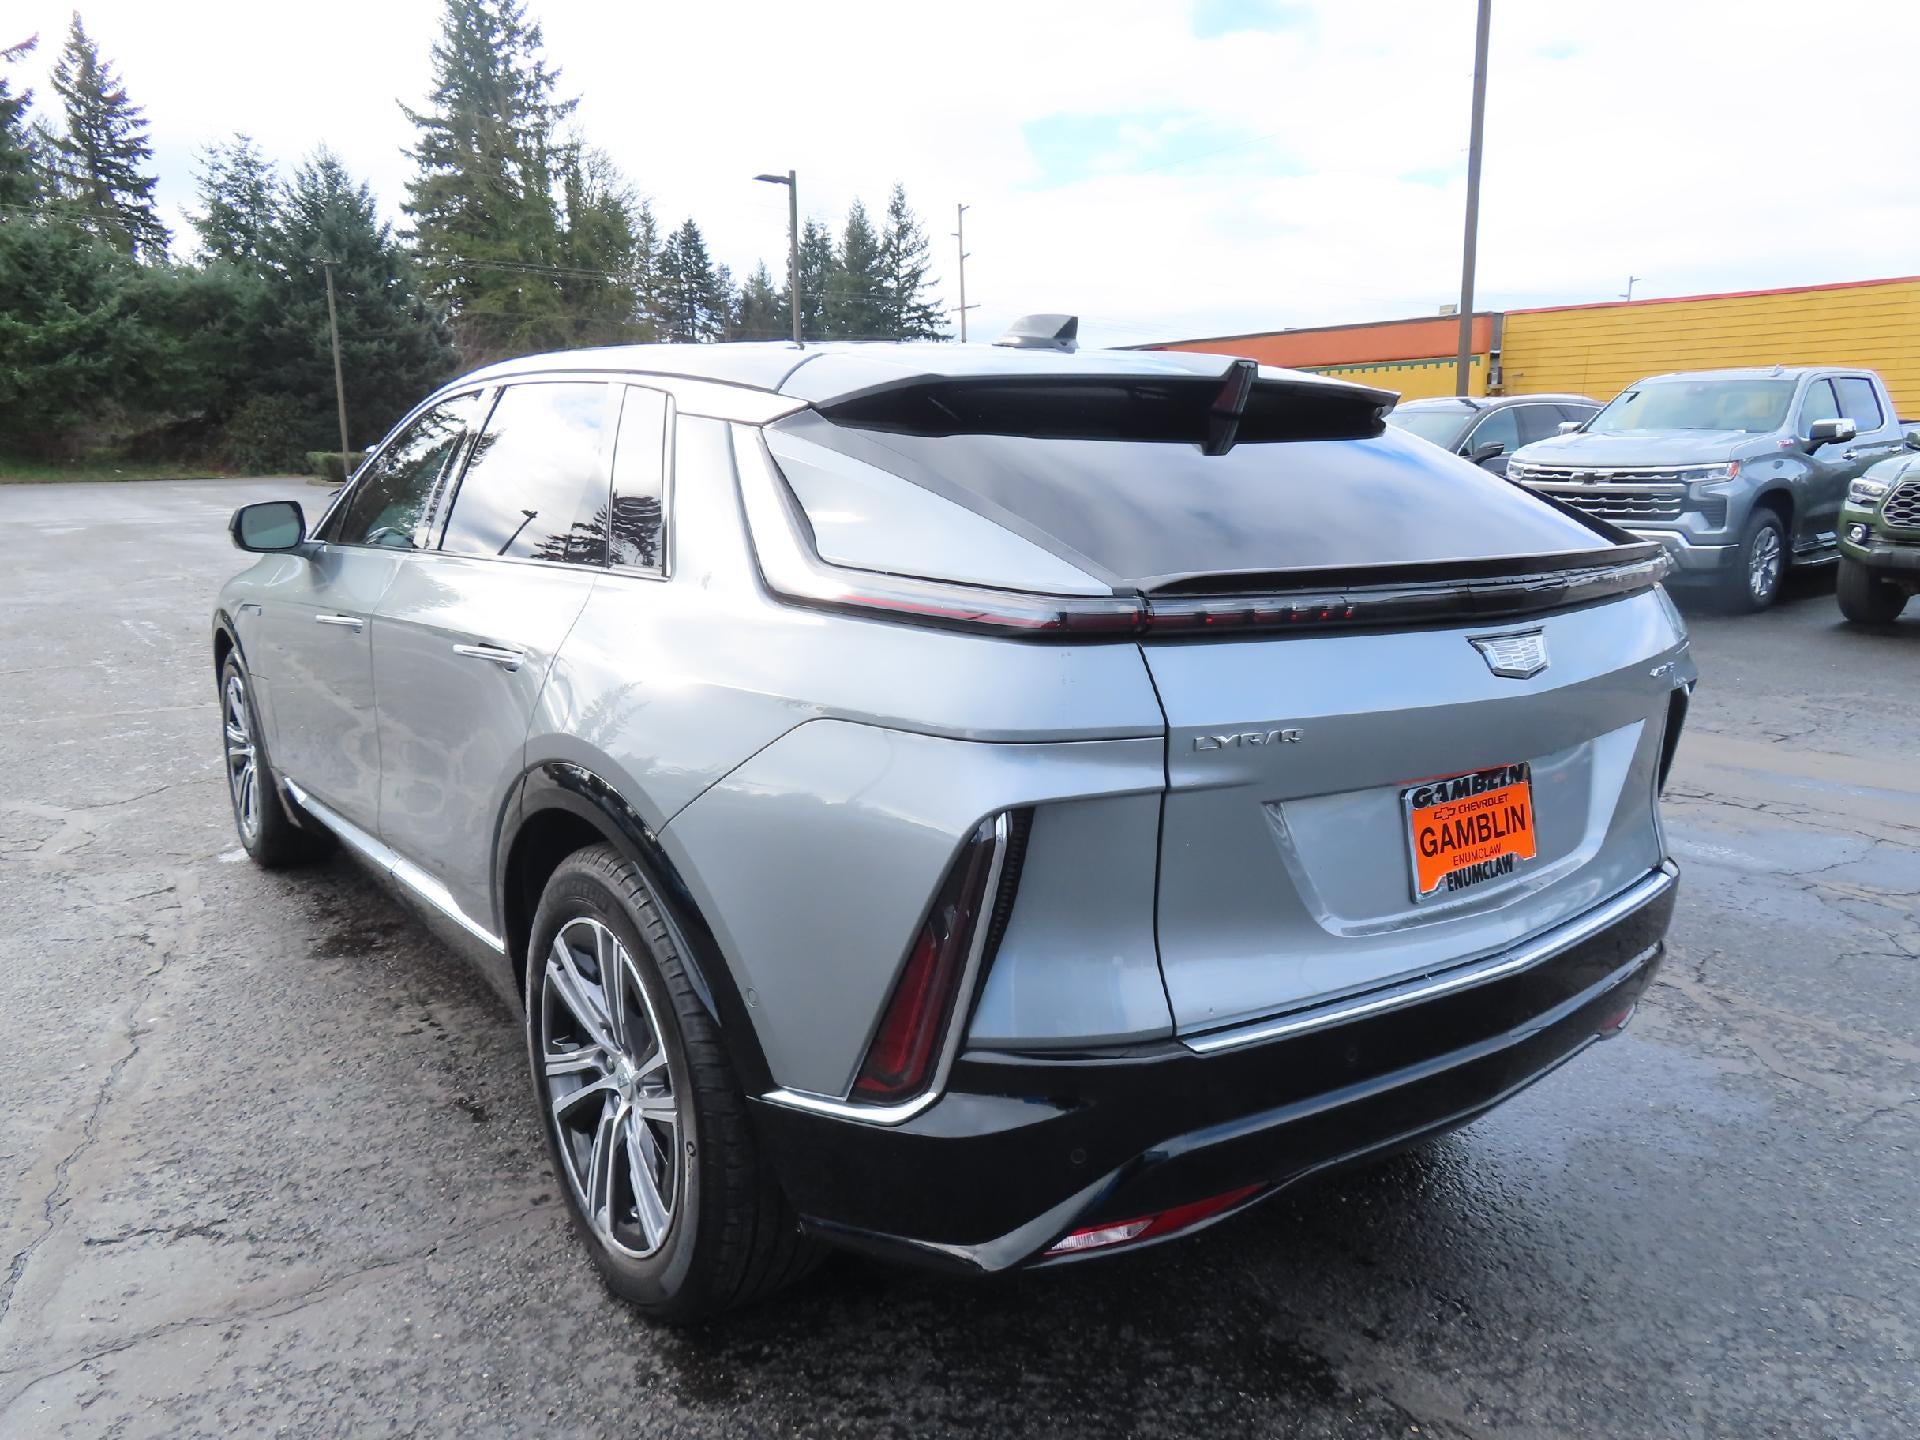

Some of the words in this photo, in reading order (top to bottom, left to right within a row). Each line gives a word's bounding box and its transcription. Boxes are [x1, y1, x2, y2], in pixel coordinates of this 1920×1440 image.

[1458, 793, 1509, 814] CHEVROLET
[1420, 804, 1525, 857] GAMBLIN
[1453, 844, 1501, 866] ENUMCLAW
[1446, 854, 1513, 891] ENUMCLAW
